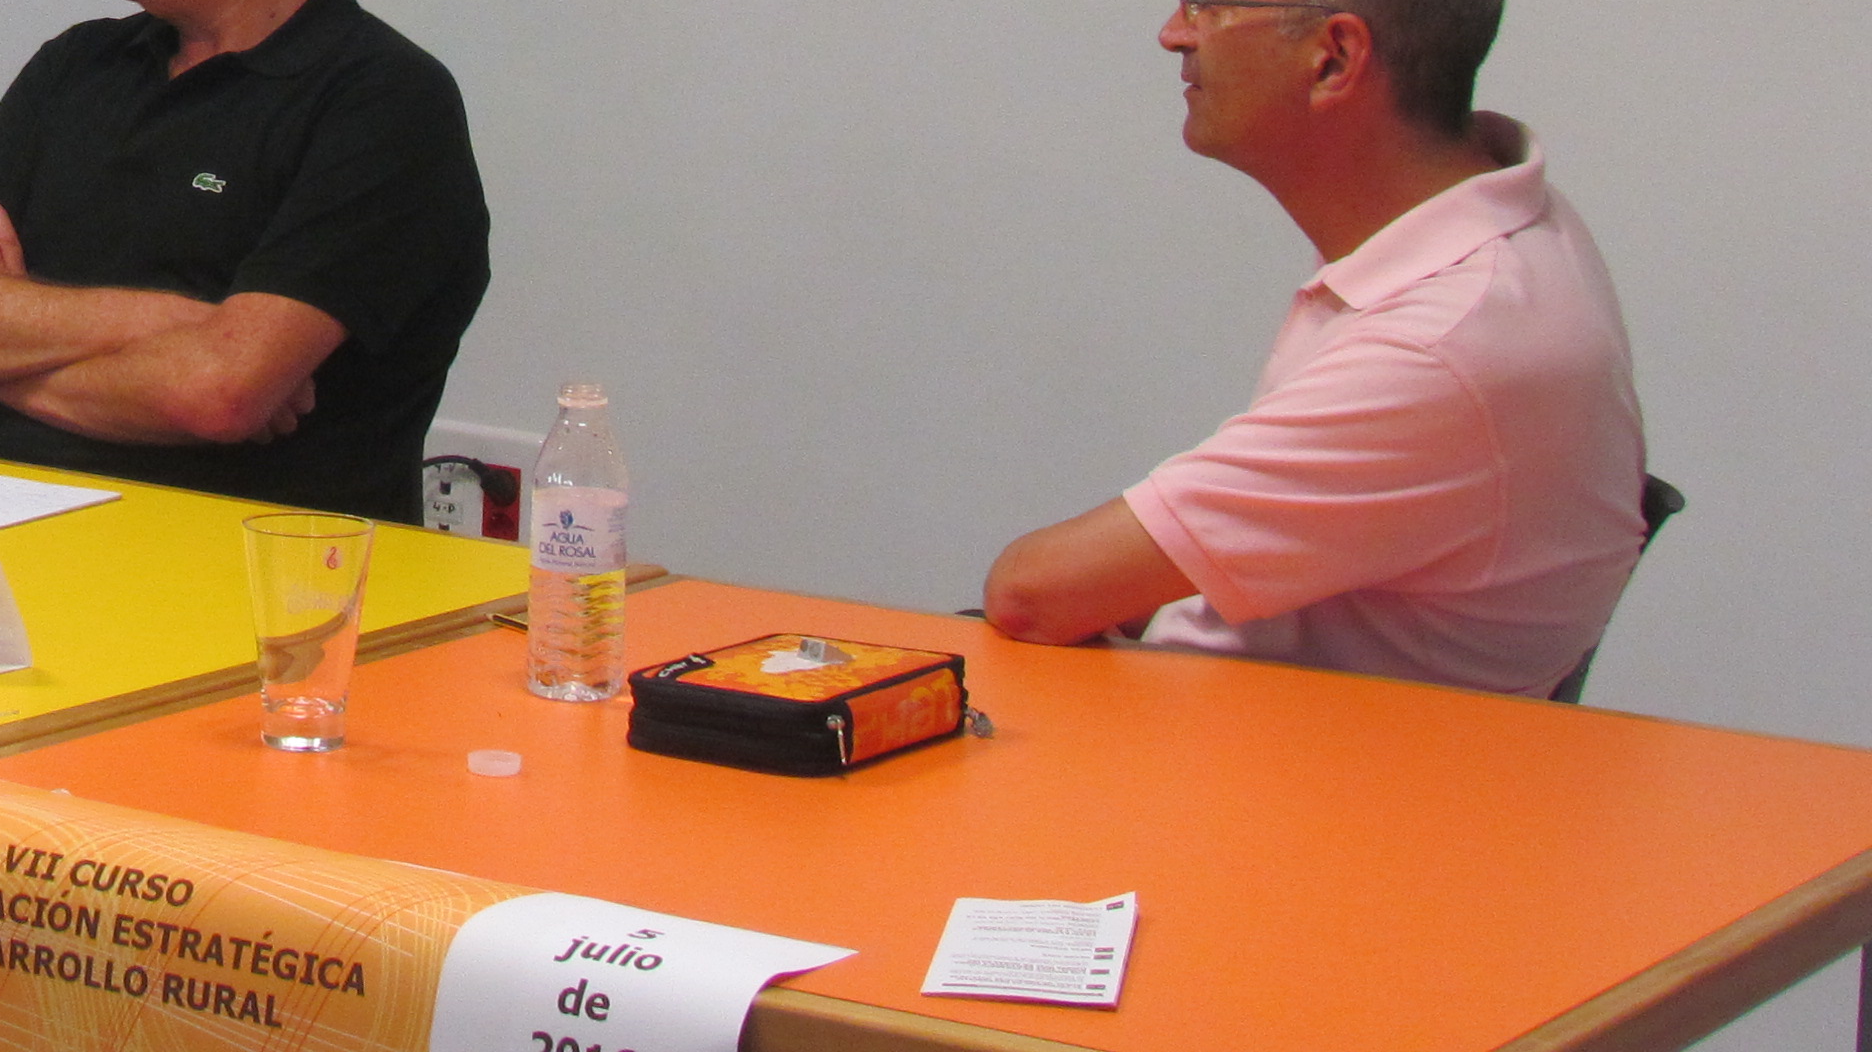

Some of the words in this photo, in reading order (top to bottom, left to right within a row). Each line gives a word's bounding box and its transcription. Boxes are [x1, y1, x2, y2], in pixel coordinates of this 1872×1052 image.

[538, 541, 556, 556] DEL
[559, 545, 597, 559] ROSAL
[550, 531, 584, 545] AGUA
[4, 844, 64, 885] VII
[68, 858, 195, 909] CURSO
[553, 935, 664, 971] julio
[626, 928, 666, 940] 5
[112, 913, 367, 998] ESTRATÉGICA
[160, 973, 284, 1030] RURAL
[557, 978, 611, 1022] de
